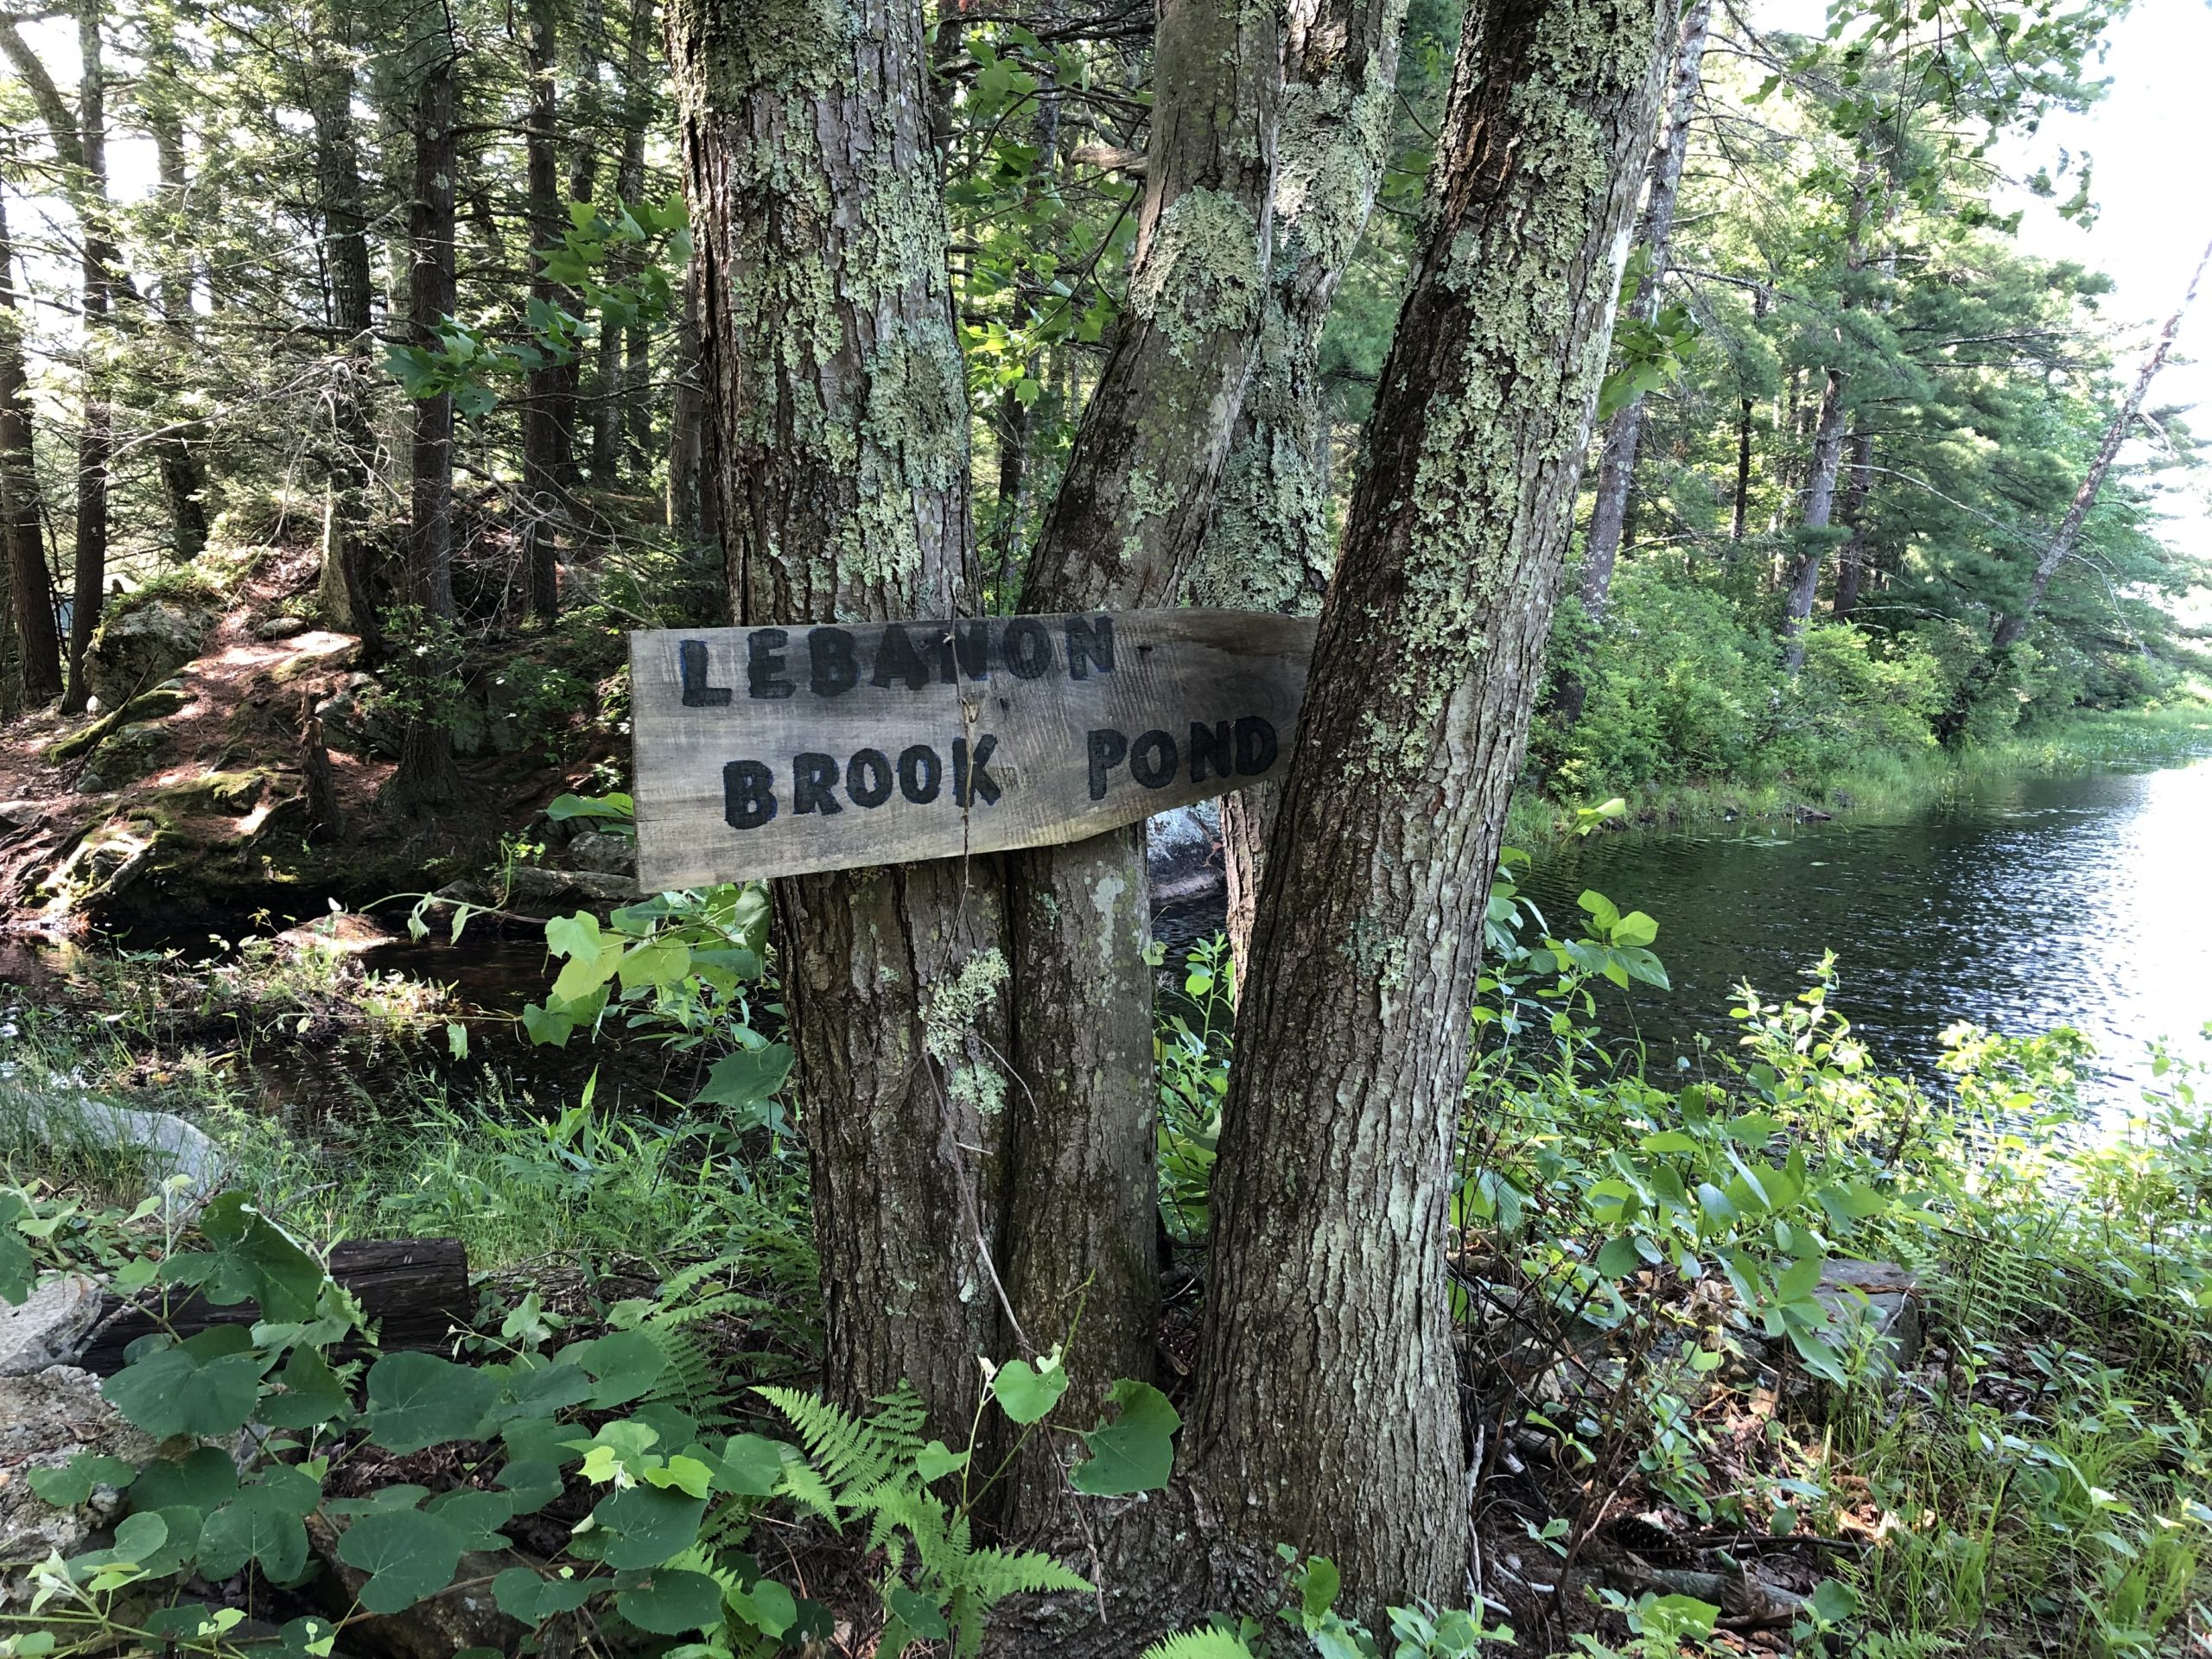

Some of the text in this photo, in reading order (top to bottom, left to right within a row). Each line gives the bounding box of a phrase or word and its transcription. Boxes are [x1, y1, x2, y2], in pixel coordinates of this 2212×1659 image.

[679, 614, 1115, 708] LEBANON
[722, 715, 1278, 830] BROOK POND
